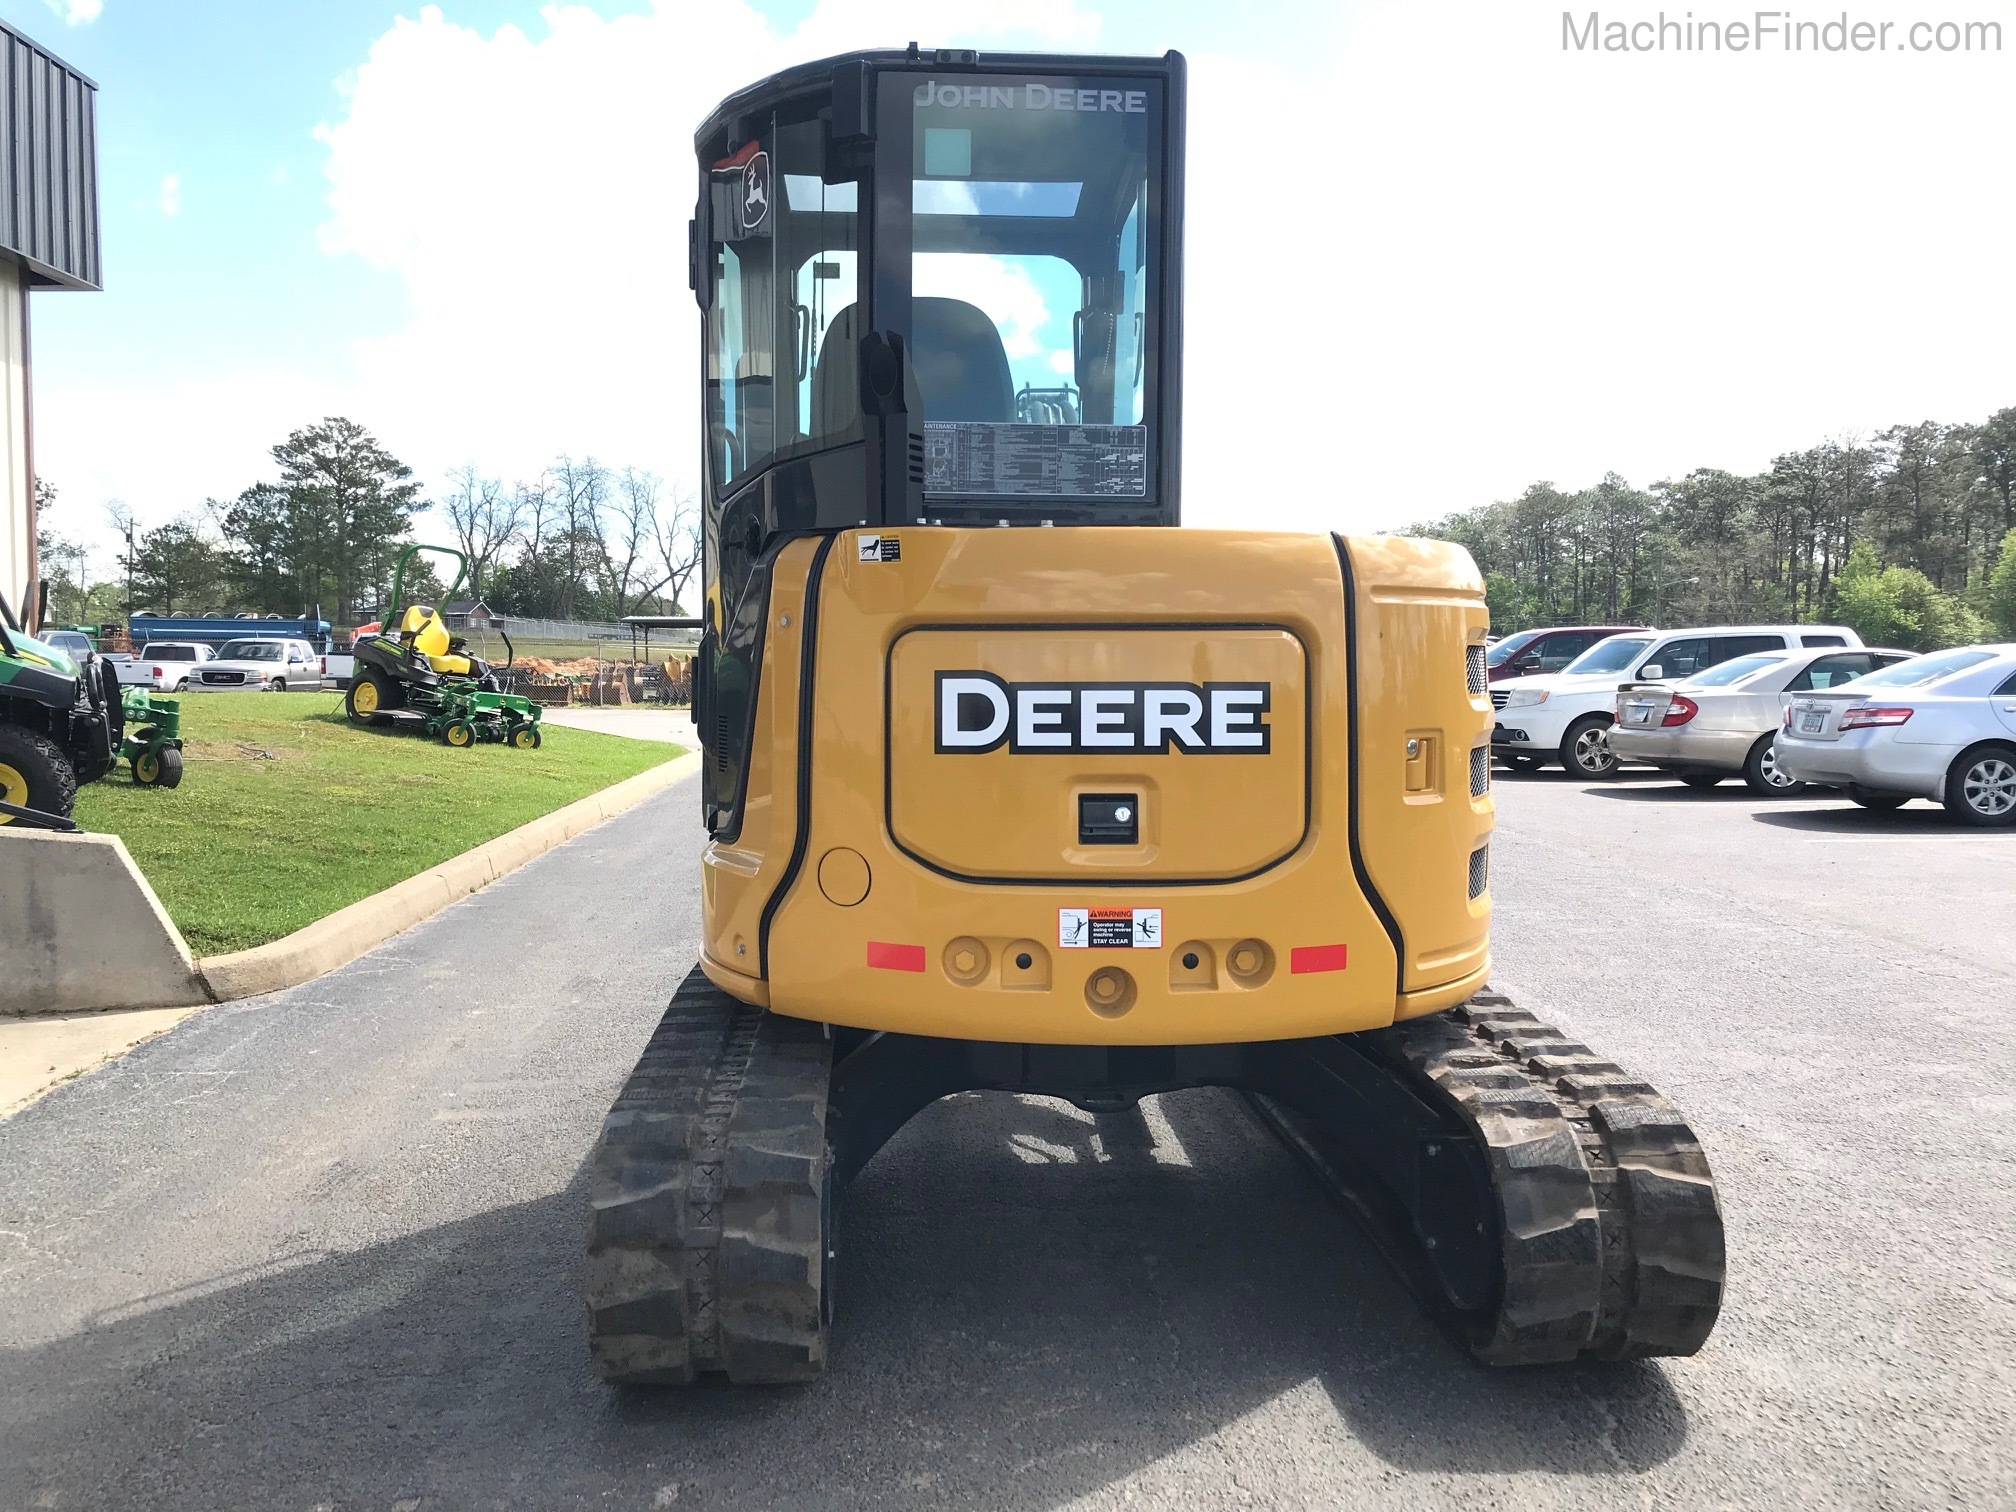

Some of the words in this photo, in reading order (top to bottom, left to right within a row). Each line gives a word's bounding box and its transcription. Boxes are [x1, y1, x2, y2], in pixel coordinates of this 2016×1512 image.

[915, 80, 1014, 109] JOHN
[1025, 83, 1147, 113] DEERE
[940, 677, 1264, 747] DEERE
